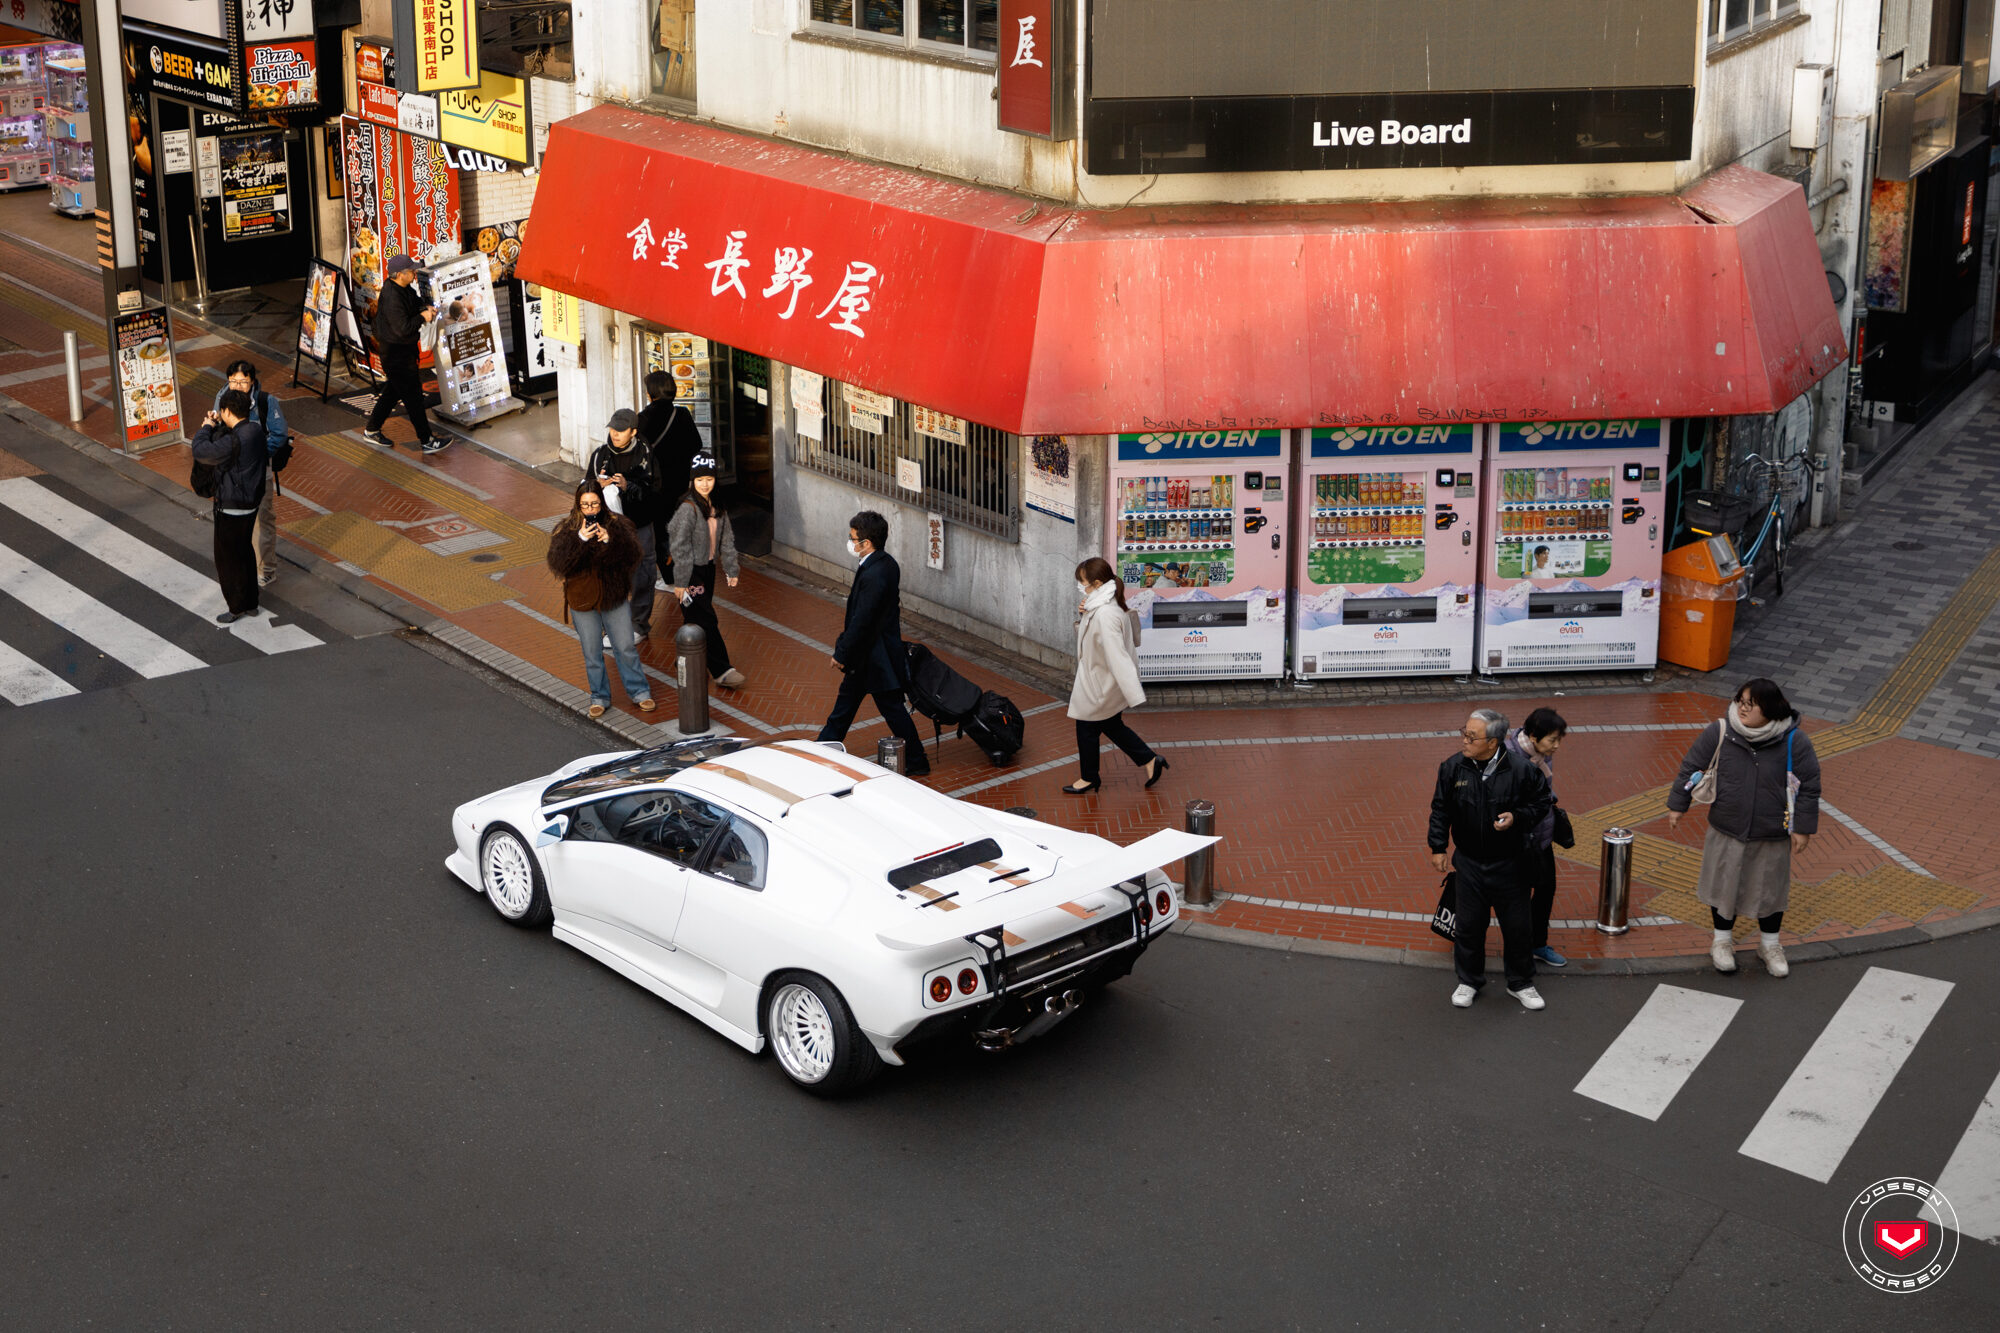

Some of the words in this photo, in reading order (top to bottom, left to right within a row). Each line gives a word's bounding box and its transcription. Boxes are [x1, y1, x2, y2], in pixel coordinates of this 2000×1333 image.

[1009, 15, 1043, 69] 屋
[254, 47, 294, 66] Pizza
[250, 62, 311, 85] Highball
[498, 109, 516, 122] SHOP
[1313, 121, 1375, 147] Live
[1381, 118, 1472, 145] Board
[347, 129, 364, 236] 本格ピザ
[240, 200, 262, 210] DAZN
[446, 276, 476, 291] Princess
[626, 217, 688, 270] 食堂
[703, 230, 877, 338] 長野屋
[1174, 430, 1221, 449] ITO
[1222, 429, 1260, 448] EN
[1366, 427, 1414, 446] ITO
[1415, 426, 1452, 444] EN
[1555, 421, 1602, 440] ITO
[1603, 420, 1640, 439] EN
[1183, 635, 1208, 643] evian
[1373, 631, 1398, 639] evian
[1559, 625, 1584, 634] evian
[1433, 921, 1450, 934] FARM
